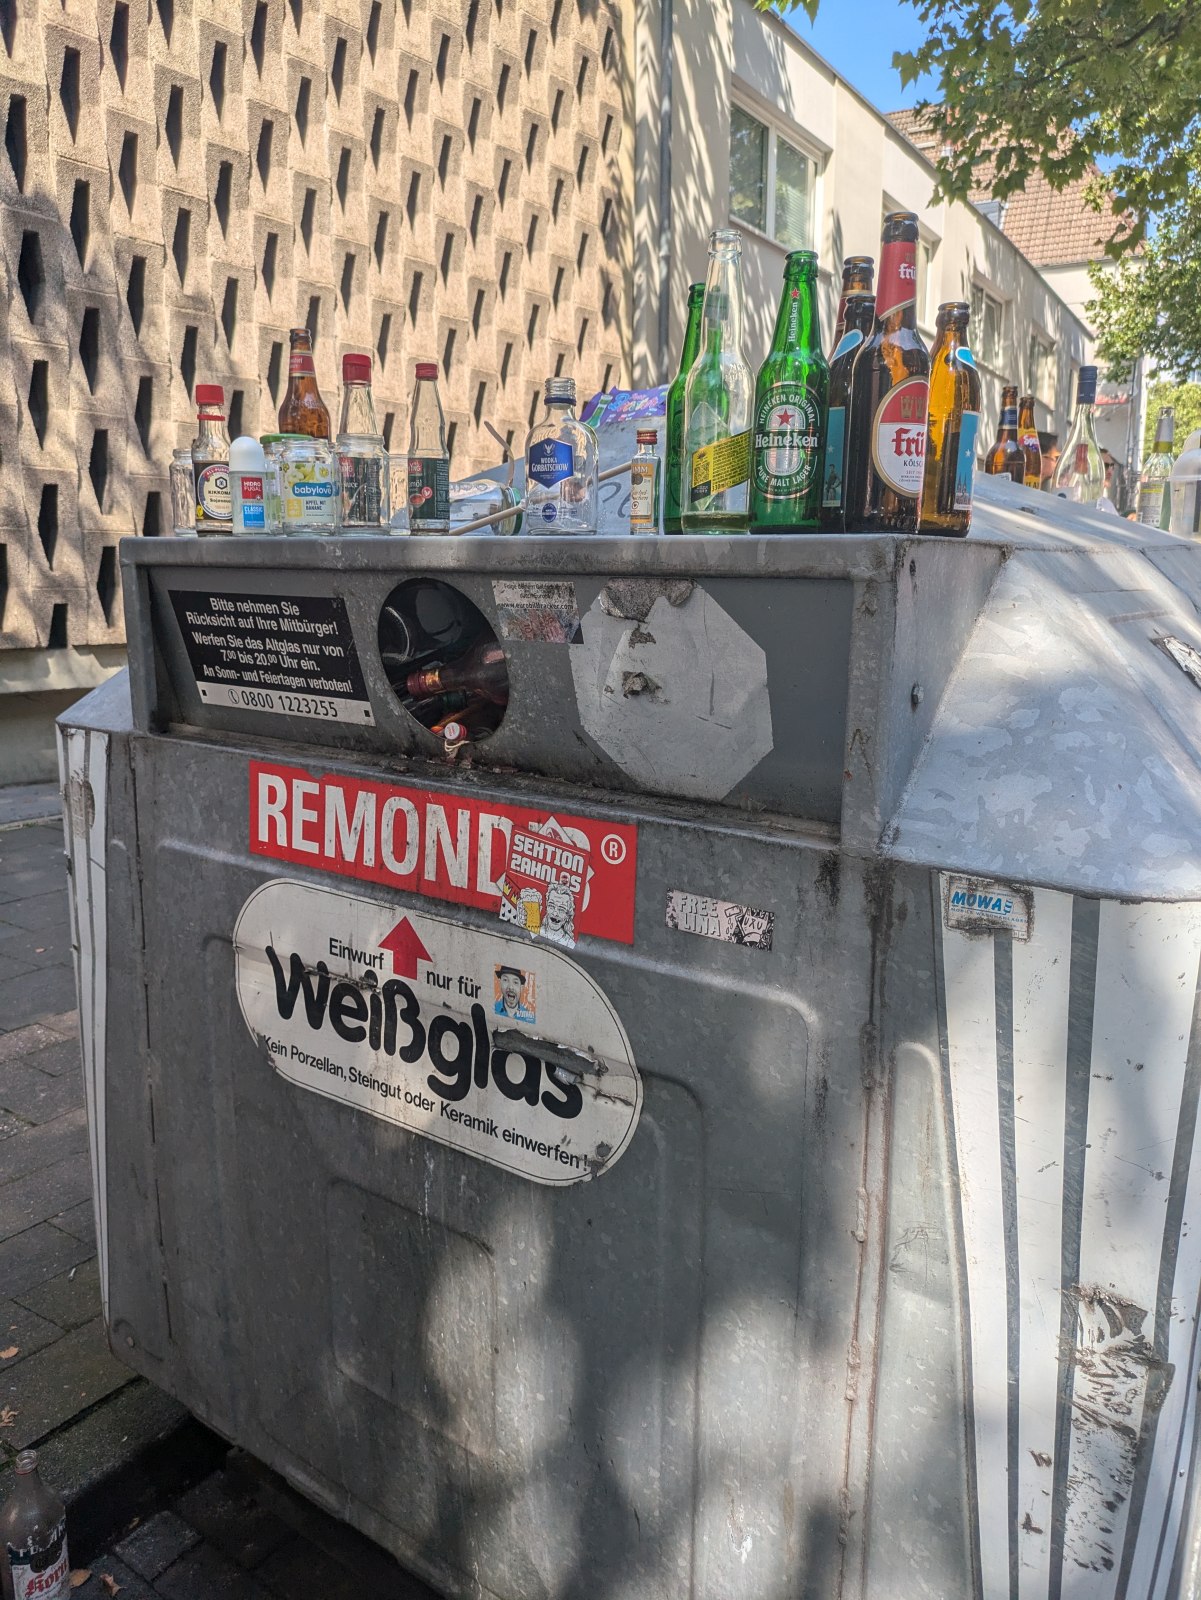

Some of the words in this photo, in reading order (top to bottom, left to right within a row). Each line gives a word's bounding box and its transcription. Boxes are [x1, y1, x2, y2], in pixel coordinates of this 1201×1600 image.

[788, 301, 798, 342] Heineken
[759, 394, 787, 424] HEINEKEN
[788, 394, 816, 423] ORIGINAL
[755, 432, 818, 448] Heineken
[531, 463, 569, 472] GORBATSCHOW
[757, 465, 769, 484] PURE
[770, 478, 790, 487] MALT
[792, 463, 812, 485] LAGER
[294, 486, 332, 496] babylove
[210, 597, 234, 612] Bitte
[237, 600, 279, 616] nehmen
[281, 602, 300, 616] Sie
[186, 611, 236, 628] Rücksicht
[238, 616, 254, 630] auf
[256, 618, 278, 631] Ihre
[280, 619, 339, 638] Mitbürger!
[192, 631, 227, 647] Werfen
[227, 634, 244, 649] Sie
[245, 636, 264, 650] das
[265, 638, 301, 656] Altglas
[302, 644, 320, 655] nur
[322, 646, 344, 657] von
[237, 651, 254, 665] bis
[280, 655, 298, 669] Uhr
[301, 658, 321, 671] ein.
[203, 664, 215, 677] An
[216, 666, 241, 680] Sonn-
[243, 669, 259, 682] und
[260, 671, 307, 689] Feiertagen
[308, 677, 353, 693] verboten!
[241, 690, 274, 709] 0800
[278, 695, 338, 717] 1223255
[680, 895, 718, 918] FREE
[951, 891, 1013, 914] MOWAS
[679, 911, 721, 938] LINA
[329, 938, 385, 970] Einwurf
[426, 968, 454, 989] nur
[457, 975, 482, 999] für
[265, 945, 584, 1119] Weißglas
[263, 1034, 288, 1058] Kein
[290, 1045, 347, 1083] Porzellan,
[347, 1067, 402, 1100] Steingut
[404, 1090, 436, 1113] oder
[440, 1100, 498, 1138] Keramik
